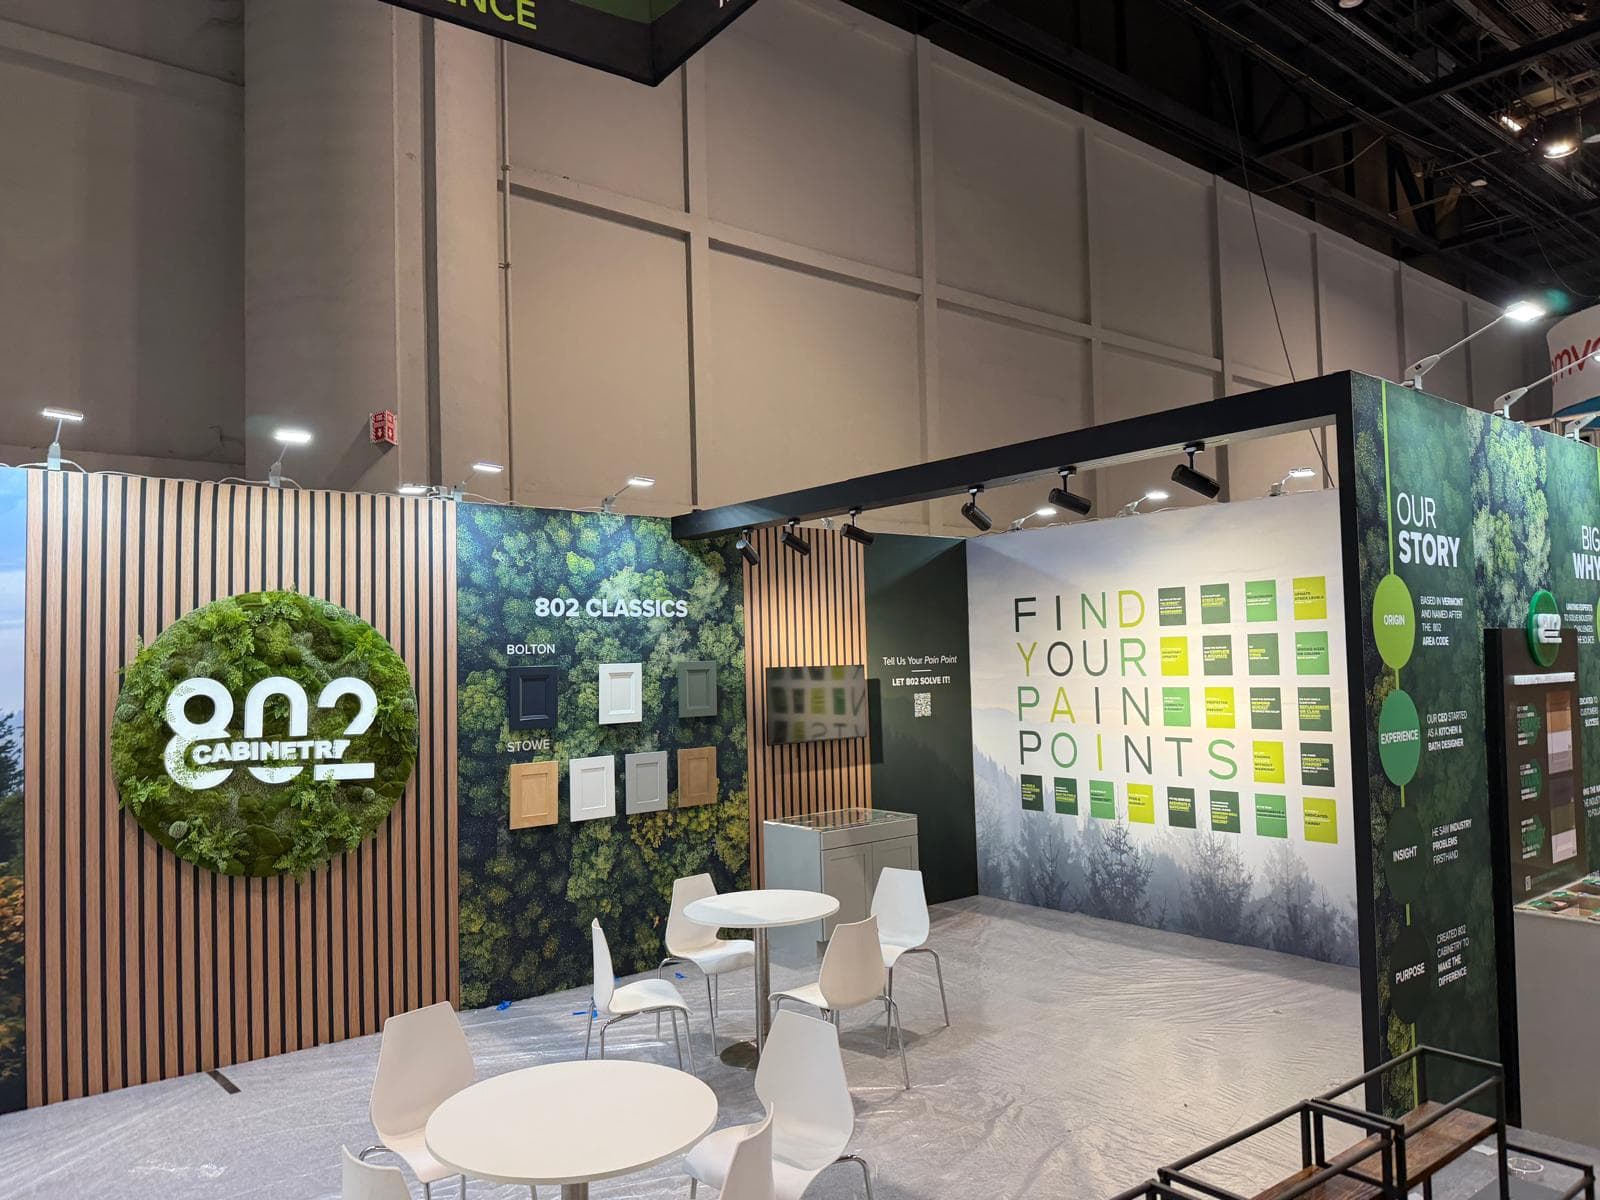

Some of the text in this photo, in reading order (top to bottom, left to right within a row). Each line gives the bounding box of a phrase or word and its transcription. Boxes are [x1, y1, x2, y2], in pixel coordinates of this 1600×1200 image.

[1396, 492, 1437, 529] OUR
[1581, 525, 1600, 553] BIG
[1398, 530, 1460, 568] STORY
[535, 597, 688, 618] 802 CLASSICS
[1420, 596, 1436, 605] BASED
[1014, 590, 1145, 633] FIND
[1383, 614, 1406, 625] ORIGIN
[1422, 623, 1431, 632] THE
[1422, 636, 1449, 646] AREA CODE
[507, 644, 556, 655] BOLTON
[1016, 637, 1147, 677] YOUR
[882, 655, 957, 666] Tell Us Your Pain Point
[892, 678, 905, 686] LET
[905, 677, 919, 686] 802
[920, 676, 942, 685] SOLVE
[1017, 686, 1150, 726] PAIN
[1426, 710, 1468, 723] OUR CEO STARTED
[164, 676, 378, 790] 802
[1381, 729, 1419, 744] EXPERIENCE
[1439, 726, 1458, 737] KITCHEN
[192, 740, 350, 765] CABINETRY
[507, 739, 551, 753] STOWE
[1428, 738, 1464, 751] BATH DESIGNER
[1019, 730, 1238, 780] POINTS
[1449, 819, 1473, 834] INDUSTRY
[1432, 837, 1458, 852] PROBLEMS
[1393, 846, 1418, 862] INSIGHT
[1432, 850, 1459, 864] FIRSTHAND
[1436, 927, 1458, 944] CREATED
[1437, 942, 1462, 958] CABINETRY
[1438, 954, 1462, 973] MAKE THE
[1395, 962, 1425, 984] PURPOSE
[1438, 966, 1467, 987] DIFFERENCE
